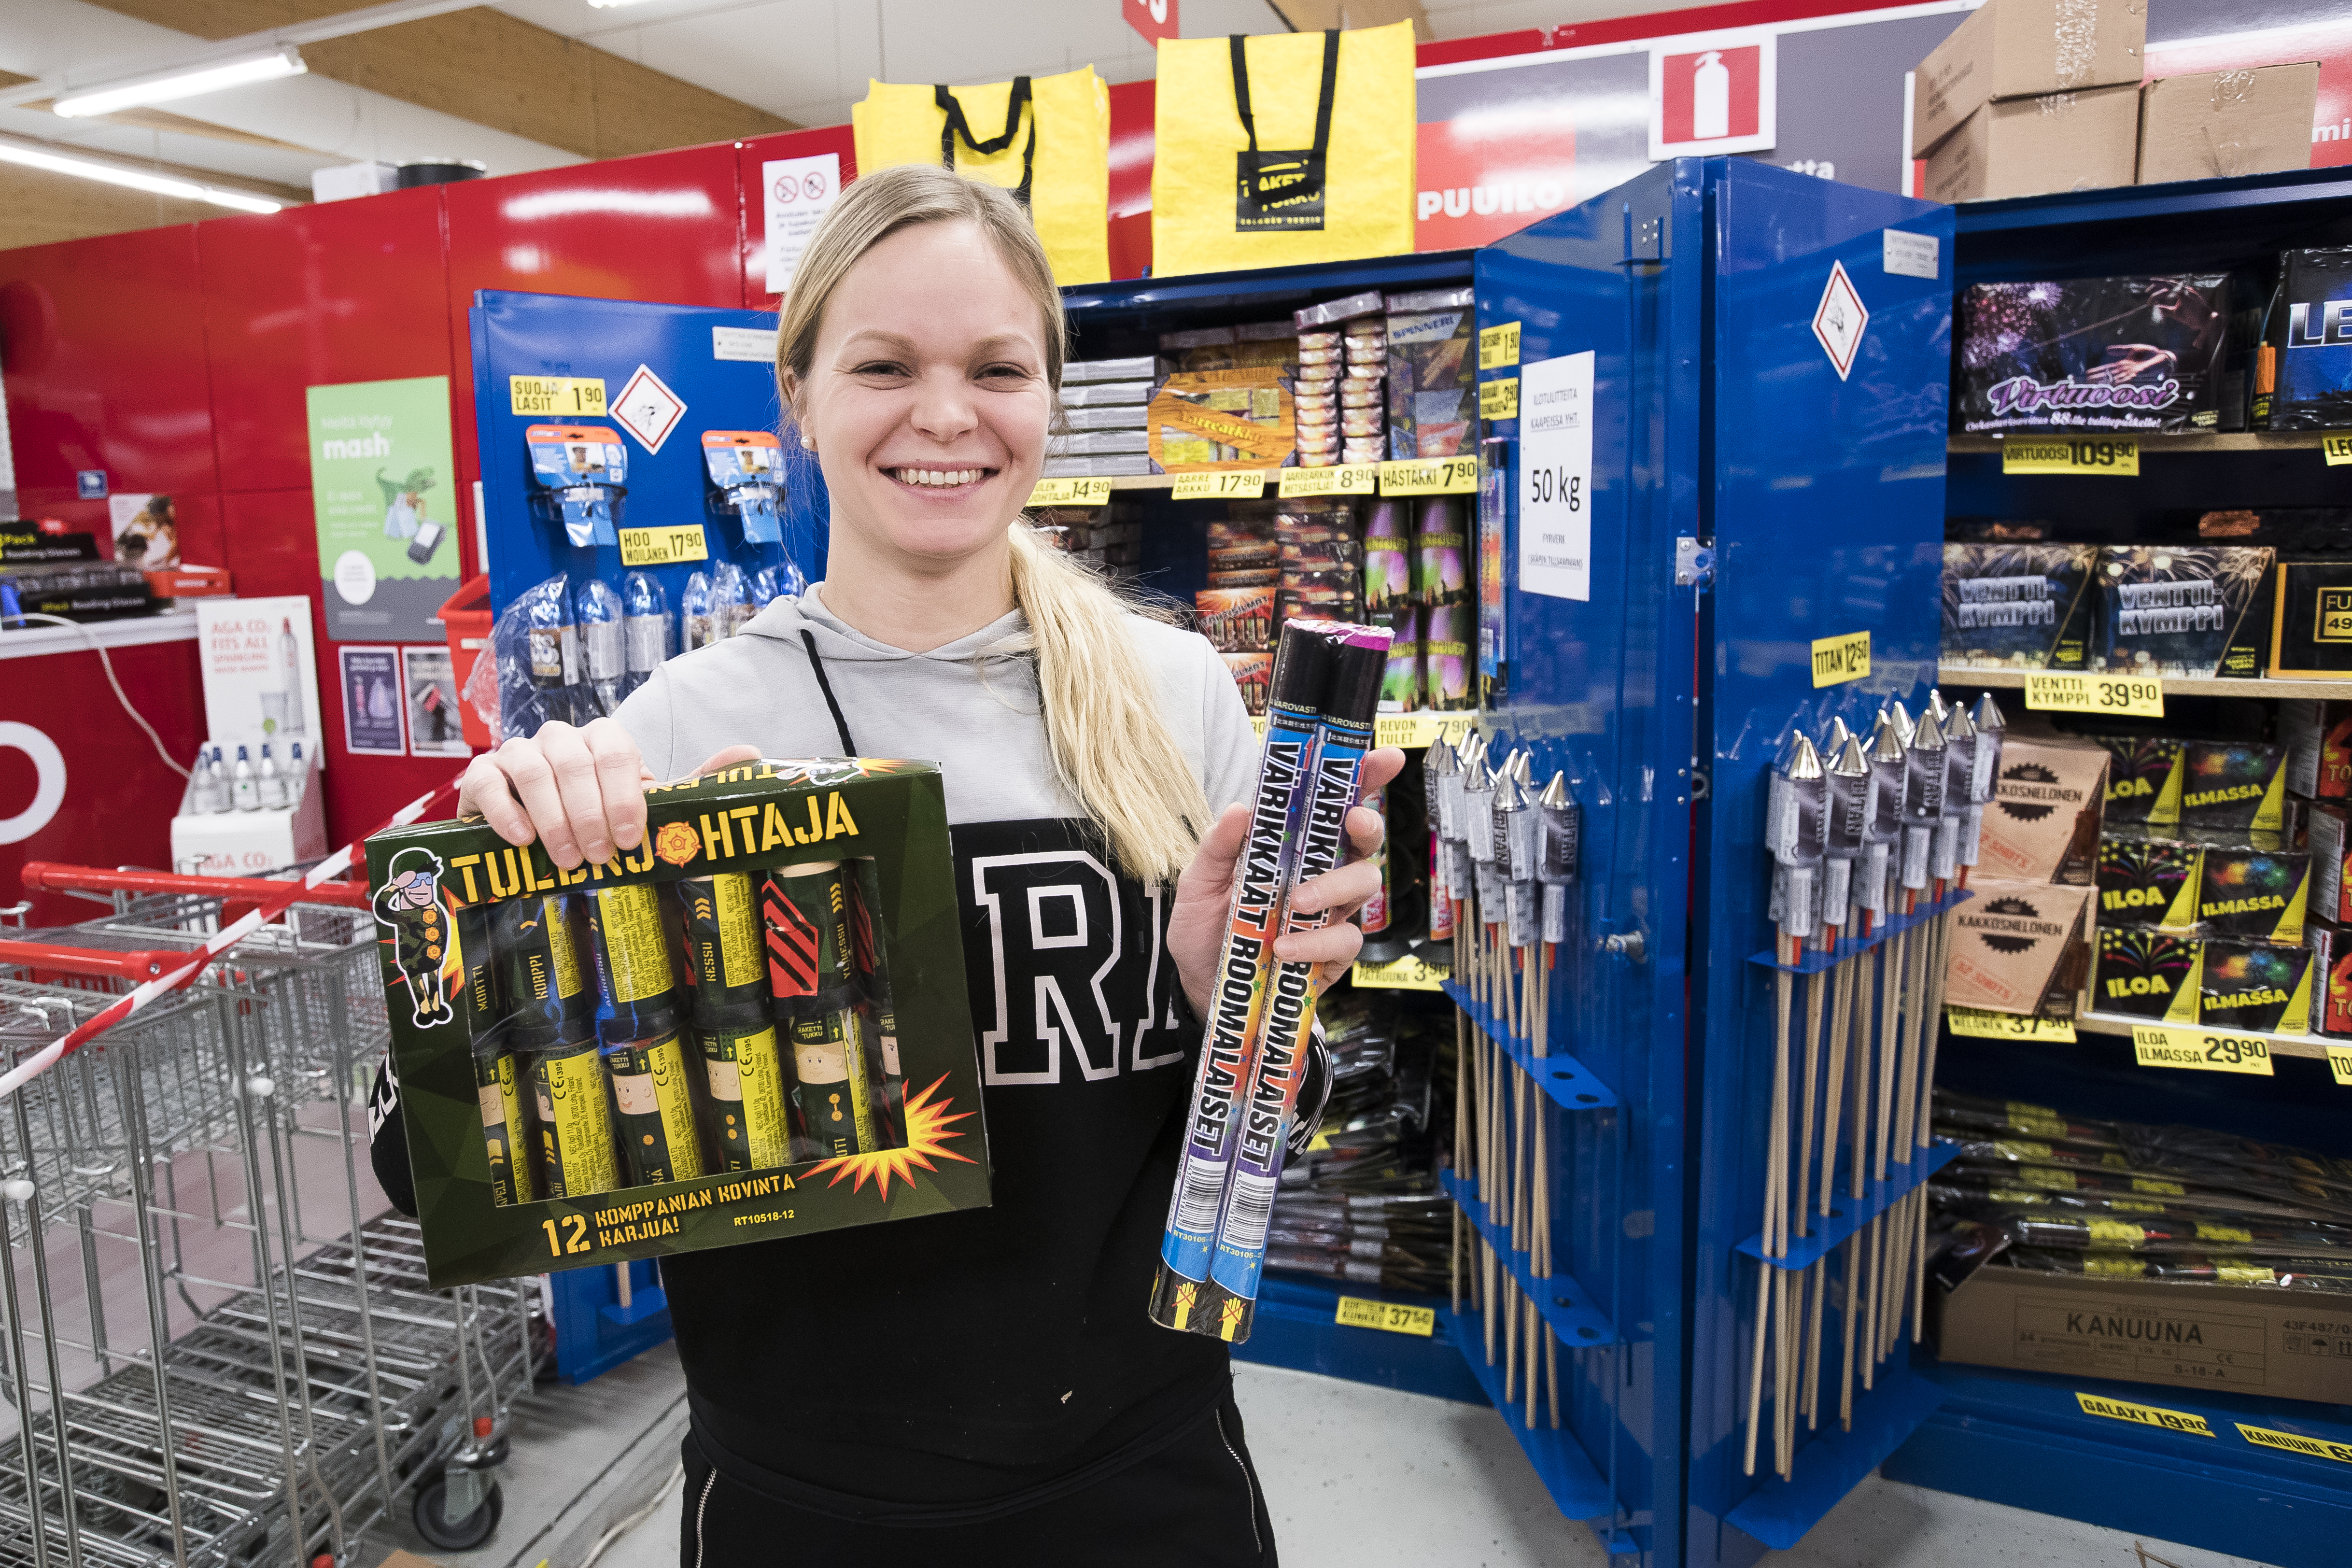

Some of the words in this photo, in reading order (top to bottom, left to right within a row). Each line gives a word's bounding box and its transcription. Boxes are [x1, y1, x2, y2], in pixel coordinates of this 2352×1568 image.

[1418, 182, 1564, 221] PUUILO
[515, 381, 558, 396] SUOJA
[1987, 376, 2180, 416] Virtuoosi
[516, 396, 551, 410] LASIT
[322, 430, 390, 460] mash
[2004, 444, 2069, 460] VIRTUOOSI
[1176, 483, 1211, 493] ARKKU
[1178, 473, 1210, 483] AARRE
[1383, 465, 1437, 488] HÄSTÄKKI
[1532, 468, 1552, 503] 50
[1559, 466, 1581, 512] kg
[624, 532, 650, 547] HOO
[1958, 599, 2056, 628] KYMPPI
[2118, 604, 2224, 636] KYMPPI
[211, 621, 243, 635] AGA
[211, 637, 239, 651] FITS
[244, 636, 268, 650] ALL
[1815, 648, 1843, 676] TITAN
[1273, 700, 1316, 714] VAROVASTI
[2031, 690, 2090, 706] KYMPPI
[1327, 716, 1371, 730] VAROVASTI
[1380, 720, 1417, 732] REVON
[1380, 733, 1413, 745] TULET
[2106, 777, 2153, 801] LOA
[2183, 784, 2264, 808] ILMASSA
[1235, 741, 1304, 932] VÄRIKKÄÄT
[2102, 886, 2165, 911] ILOA
[2201, 895, 2286, 918] ILMASSA
[1958, 916, 2063, 936] KAKKOSNELONEN
[702, 942, 717, 982] KESSU
[472, 964, 488, 1012] MORTTI
[528, 955, 549, 1000] KORPPI
[2107, 975, 2171, 999] ILOA
[2203, 988, 2289, 1012] ILMASSA
[744, 1038, 753, 1057] 1395
[1189, 933, 1266, 1158] ROOMALAISET
[2137, 1031, 2169, 1046] ILOA
[656, 1047, 666, 1066] 1395
[2139, 1048, 2203, 1064] ILMASSA
[554, 1061, 564, 1079] 1395
[568, 1144, 577, 1155] NEC
[718, 1173, 796, 1203] KOVINTA
[594, 1188, 713, 1229] KOMPPANIAN
[733, 1209, 795, 1227] RT10518-12
[542, 1214, 591, 1257] 12
[598, 1216, 680, 1247] KARJUA!
[1224, 1210, 1235, 1237] 818882
[1219, 1244, 1263, 1259] RT30105-2
[2066, 1312, 2204, 1346] KANUUNA
[2083, 1399, 2149, 1423] GALAXY
[2242, 1428, 2327, 1455] KANUUNA
